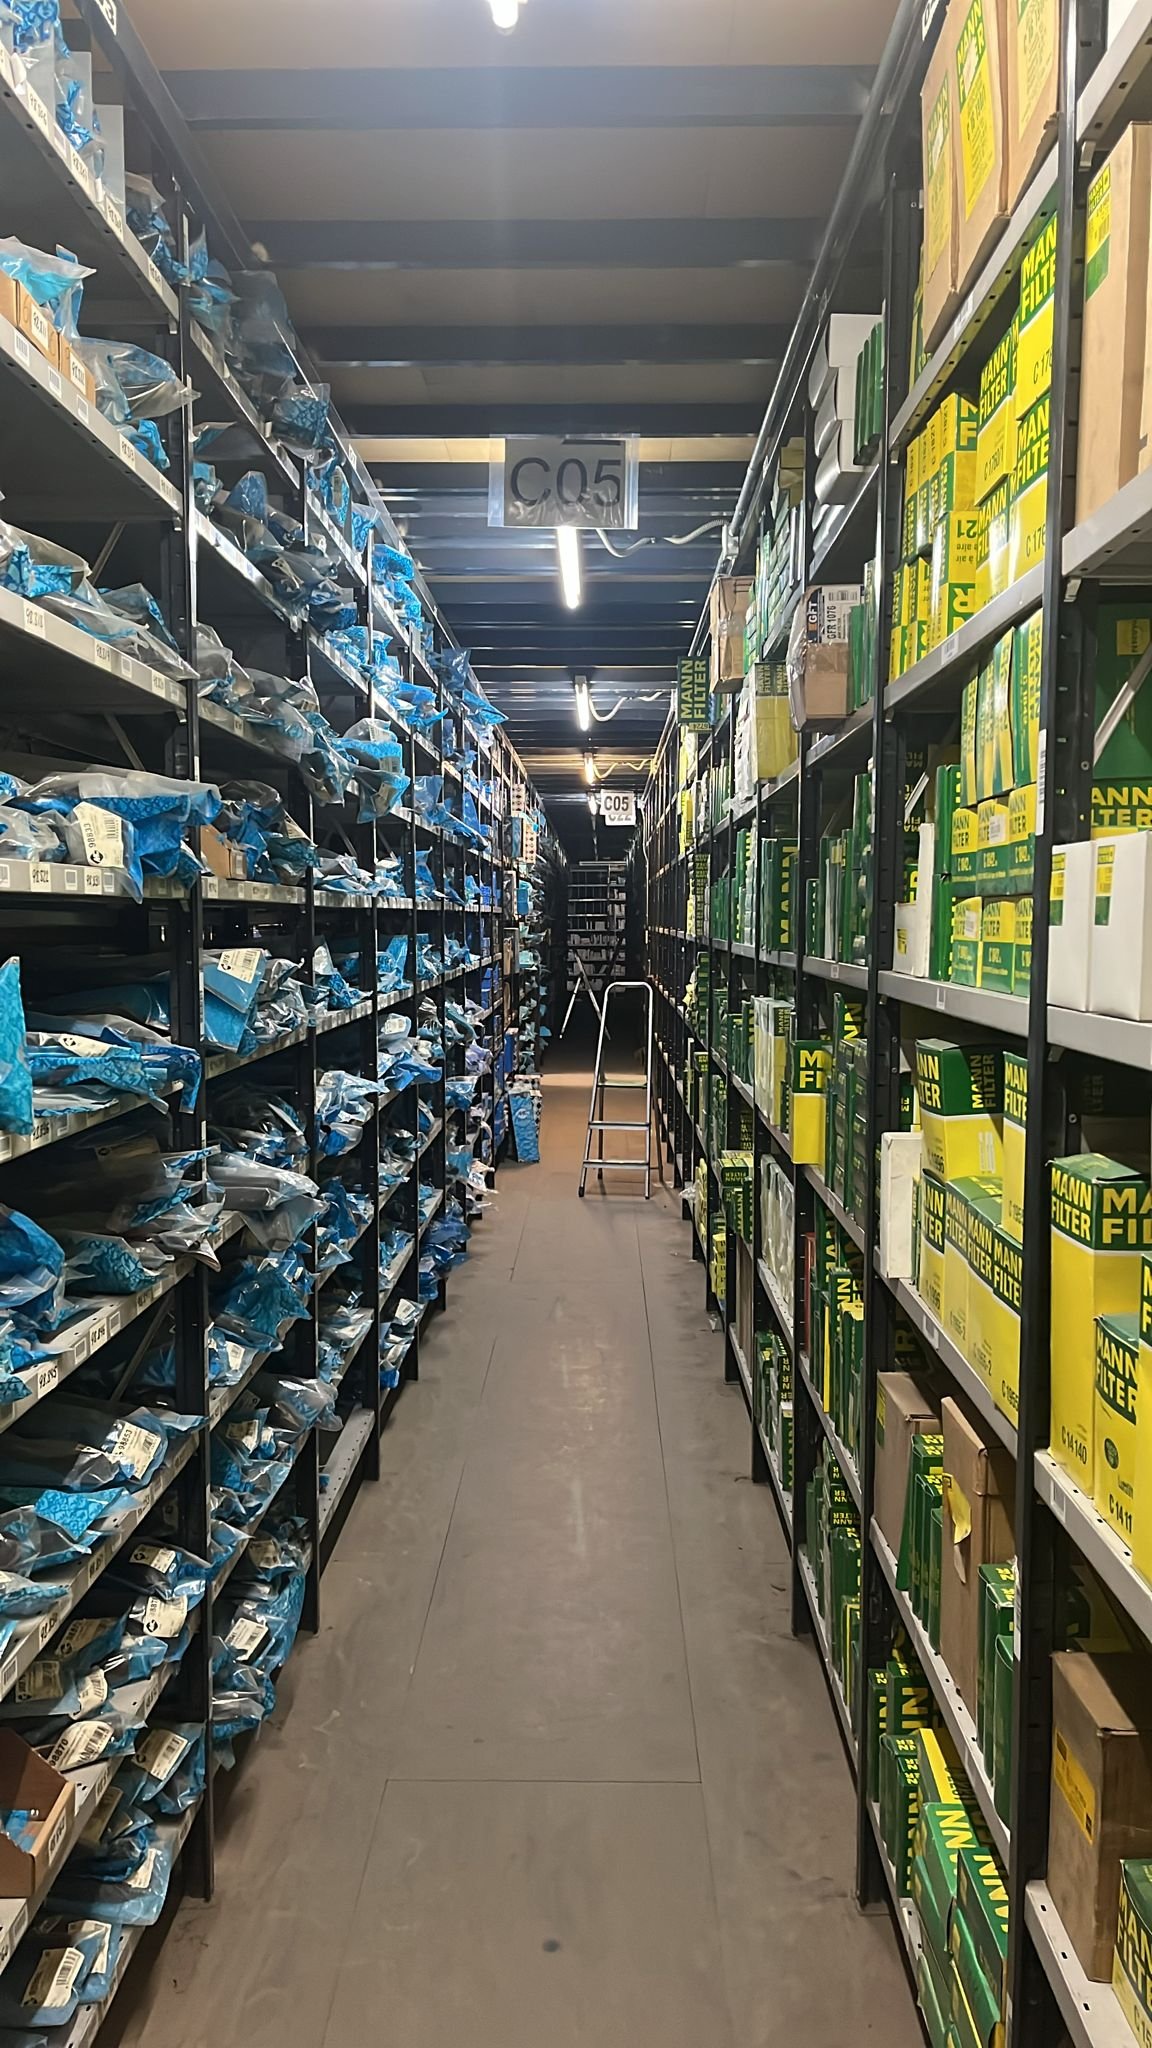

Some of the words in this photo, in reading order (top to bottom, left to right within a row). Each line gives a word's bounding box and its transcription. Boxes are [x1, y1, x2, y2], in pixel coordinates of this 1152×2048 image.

[981, 335, 1011, 395] MANN
[979, 366, 1008, 426] FILTER
[510, 456, 621, 507] C05
[978, 482, 1007, 539] MANN
[808, 601, 817, 624] GFT
[827, 624, 836, 640] GFR
[681, 660, 694, 719] MANN
[694, 660, 706, 719] FILTER
[603, 795, 629, 812] C05
[970, 1055, 985, 1109] MANN
[982, 1053, 996, 1108] FILTER
[946, 1190, 968, 1227] MANN
[1051, 1166, 1092, 1212] MANN
[945, 1216, 968, 1253] FILTER
[969, 1210, 993, 1255] MANN
[1051, 1194, 1091, 1242] FILTER
[968, 1239, 993, 1282] FILTER
[1097, 1331, 1139, 1388] MANN
[1001, 1379, 1006, 1397] C
[1096, 1363, 1138, 1413] FILTER
[1062, 1426, 1067, 1445] C
[1067, 1431, 1075, 1453] 14
[1074, 1438, 1088, 1465] 140
[1109, 1494, 1115, 1514] C
[1116, 1500, 1125, 1527] 14
[1134, 2003, 1141, 2031] C
